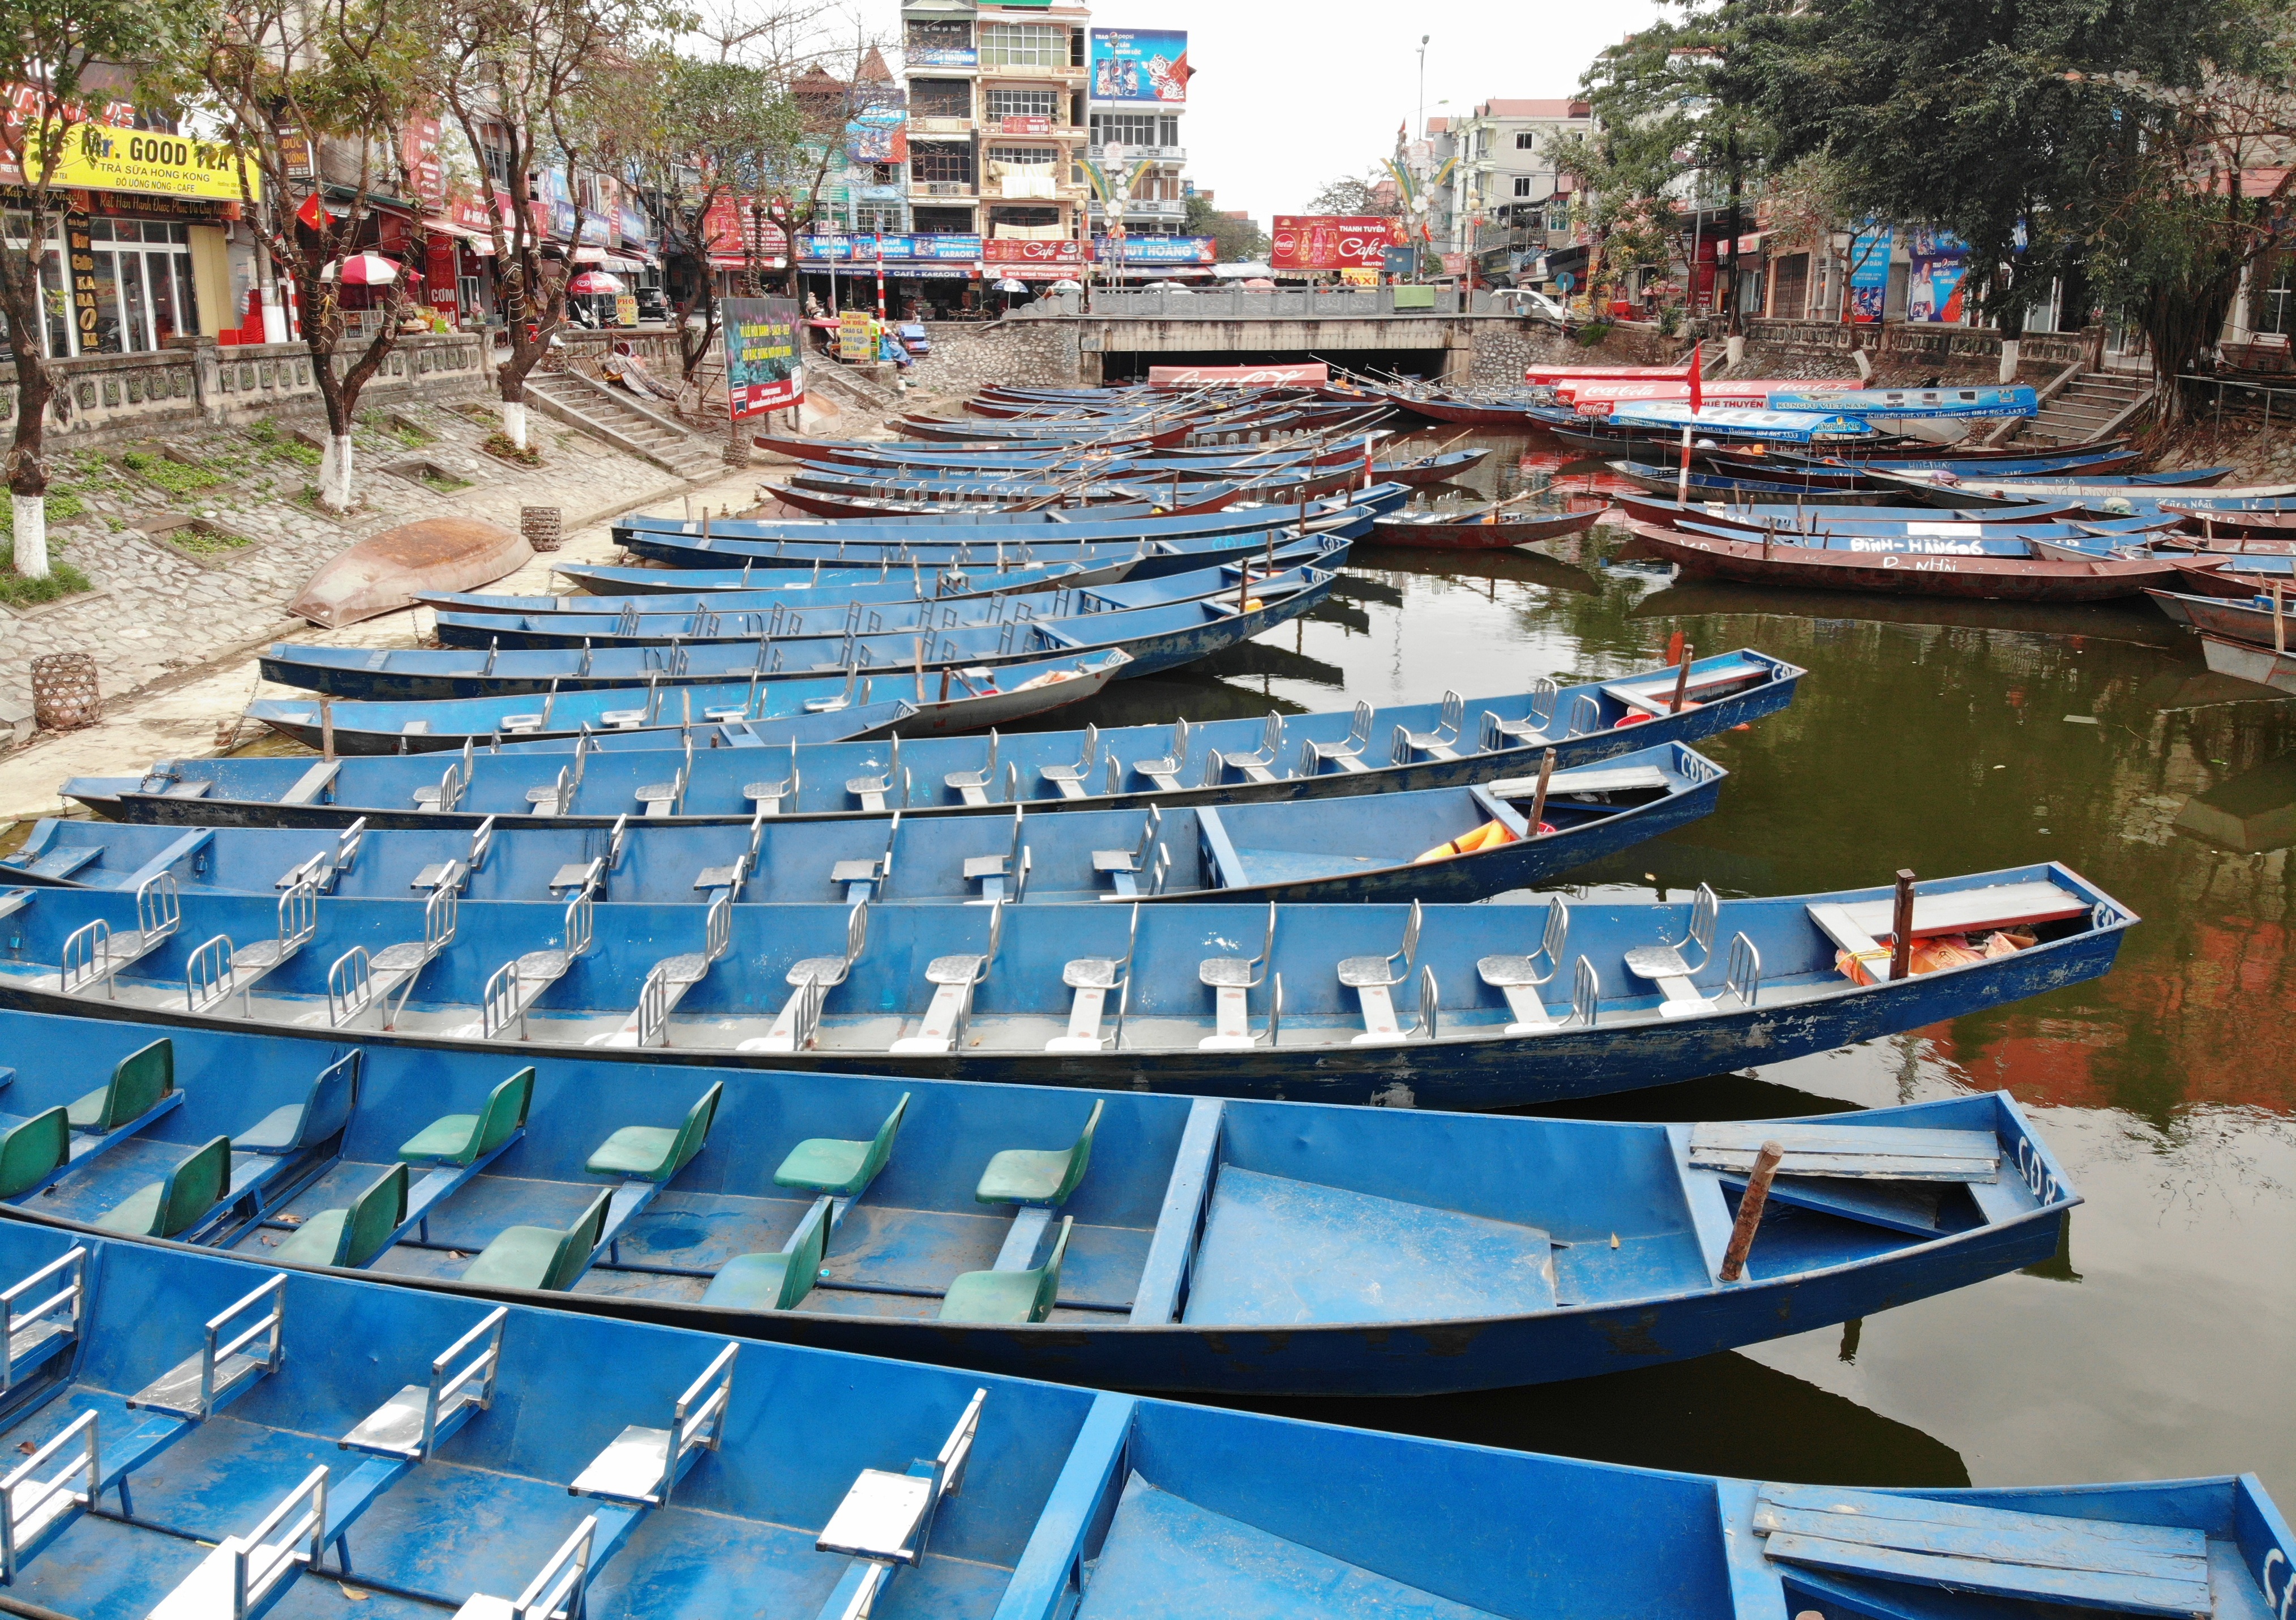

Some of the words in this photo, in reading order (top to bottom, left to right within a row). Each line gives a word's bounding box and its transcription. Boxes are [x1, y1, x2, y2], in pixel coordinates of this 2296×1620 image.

[130, 137, 187, 166] GOOD
[101, 163, 122, 173] TRÀ
[151, 169, 180, 179] HONG
[183, 172, 210, 182] KONG
[177, 183, 195, 193] CAFE
[1023, 242, 1056, 259] Café
[1339, 238, 1380, 260] Café
[1947, 259, 1959, 267] pepsi
[431, 287, 455, 302] CƠM
[80, 308, 97, 330] O
[1585, 385, 1655, 396] Coca-Cola
[1577, 402, 1610, 413] Coca-Cola
